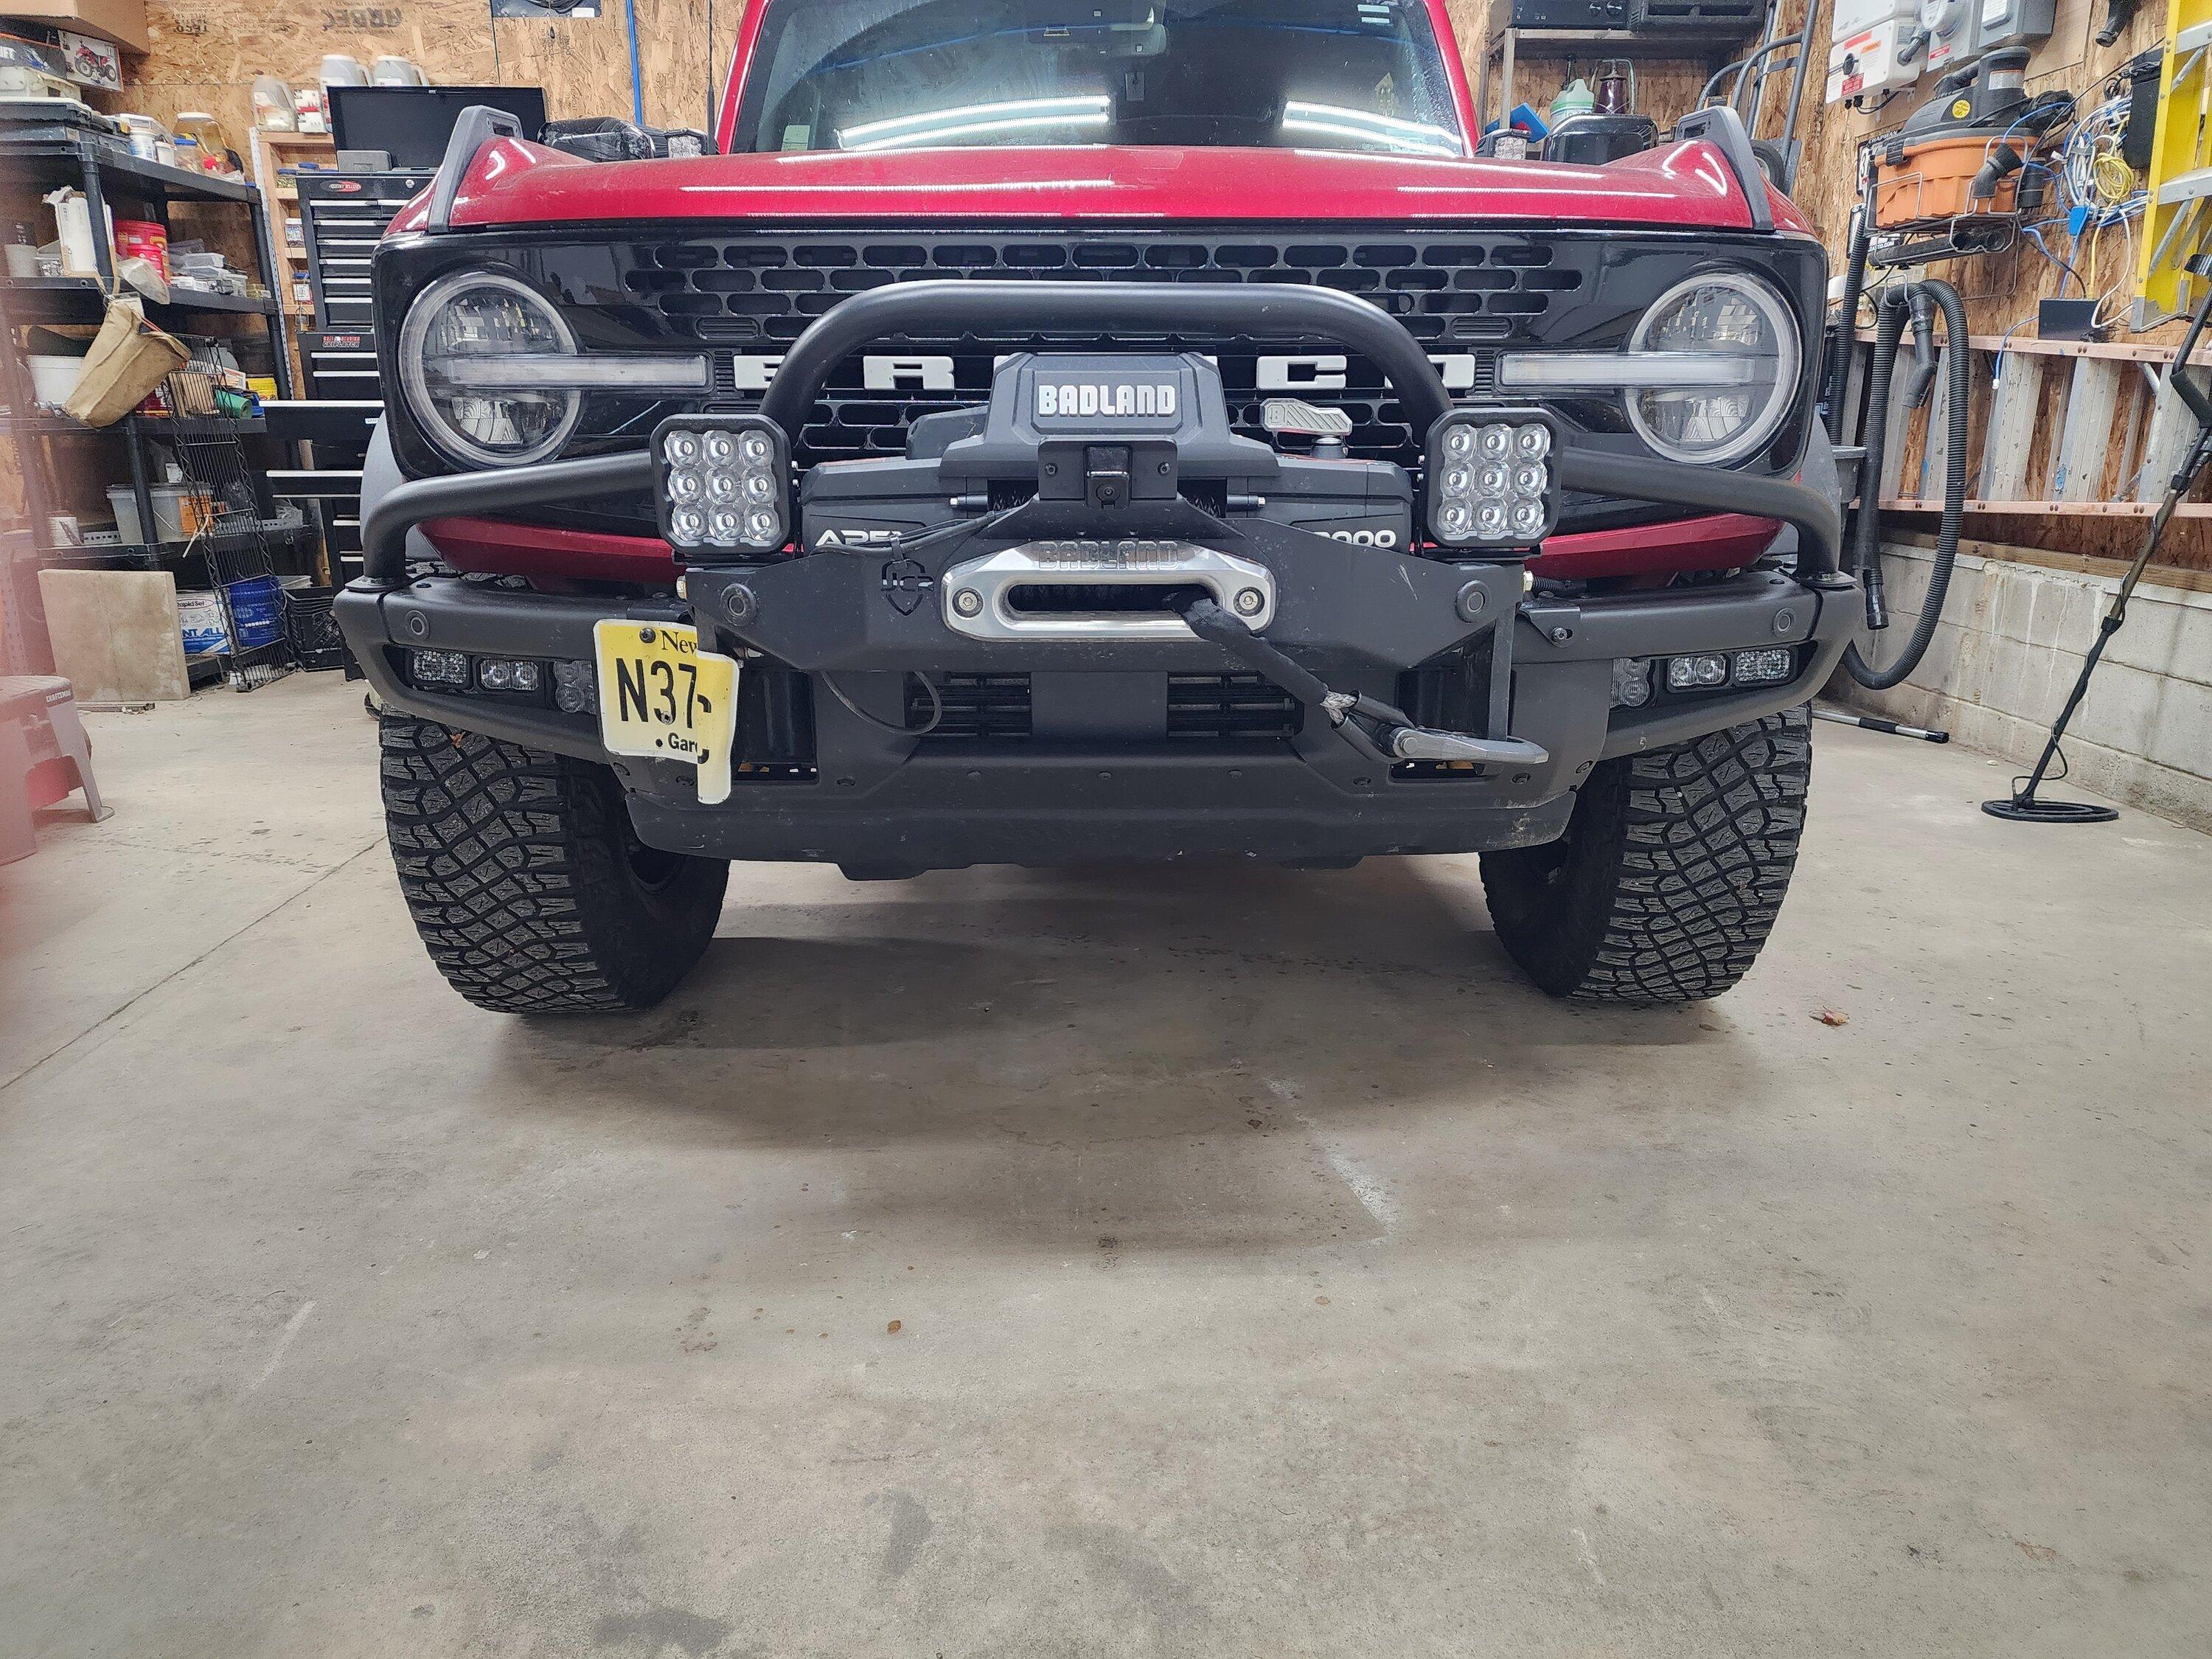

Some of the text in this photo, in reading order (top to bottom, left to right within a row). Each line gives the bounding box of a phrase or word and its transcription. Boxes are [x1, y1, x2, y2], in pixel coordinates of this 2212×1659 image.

[1038, 385, 1175, 417] BADLAND
[818, 529, 903, 546] APE
[1038, 540, 1178, 571] BADLAND
[200, 627, 223, 636] ALL
